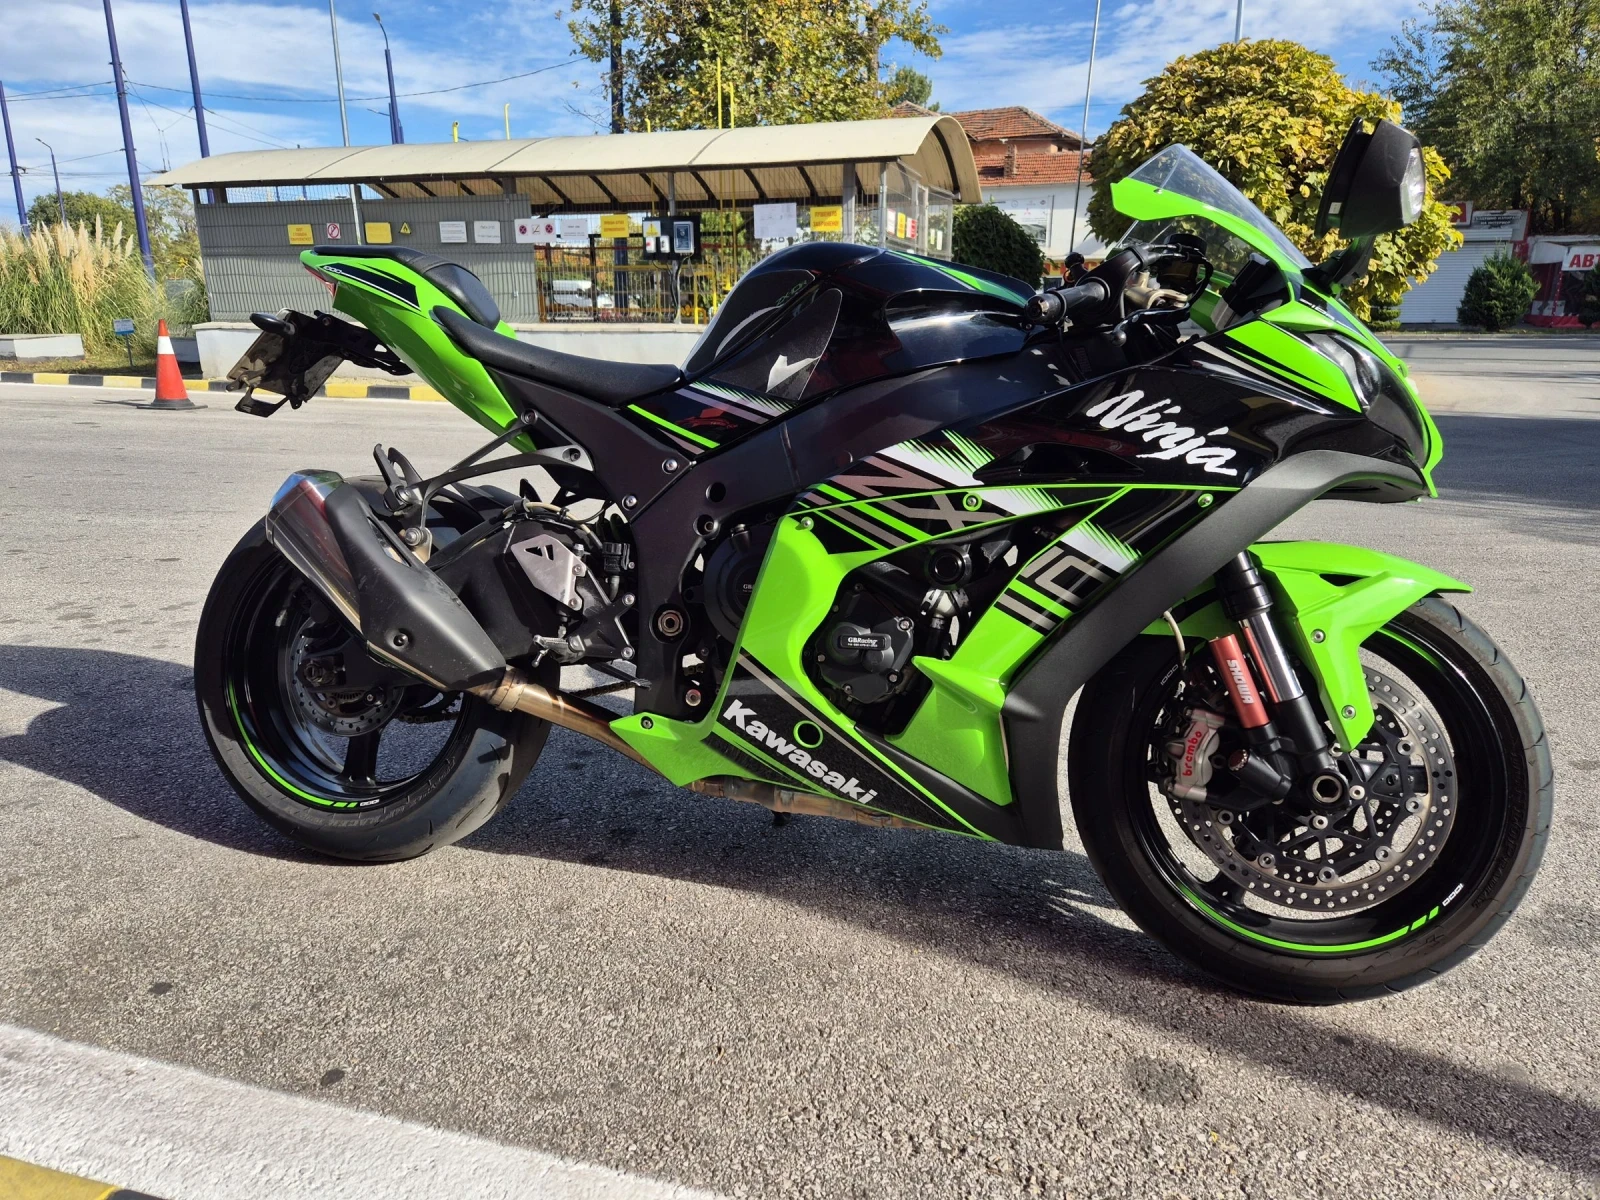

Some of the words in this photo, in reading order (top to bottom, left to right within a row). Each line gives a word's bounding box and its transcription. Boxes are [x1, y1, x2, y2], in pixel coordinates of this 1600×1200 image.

[1085, 389, 1237, 476] Ninja
[847, 636, 878, 647] GBRacing
[1160, 664, 1179, 685] 1000
[1227, 659, 1254, 704] SHOWA
[723, 699, 878, 804] Kawasaki
[1183, 731, 1202, 776] brembo
[1442, 883, 1464, 907] 1000
